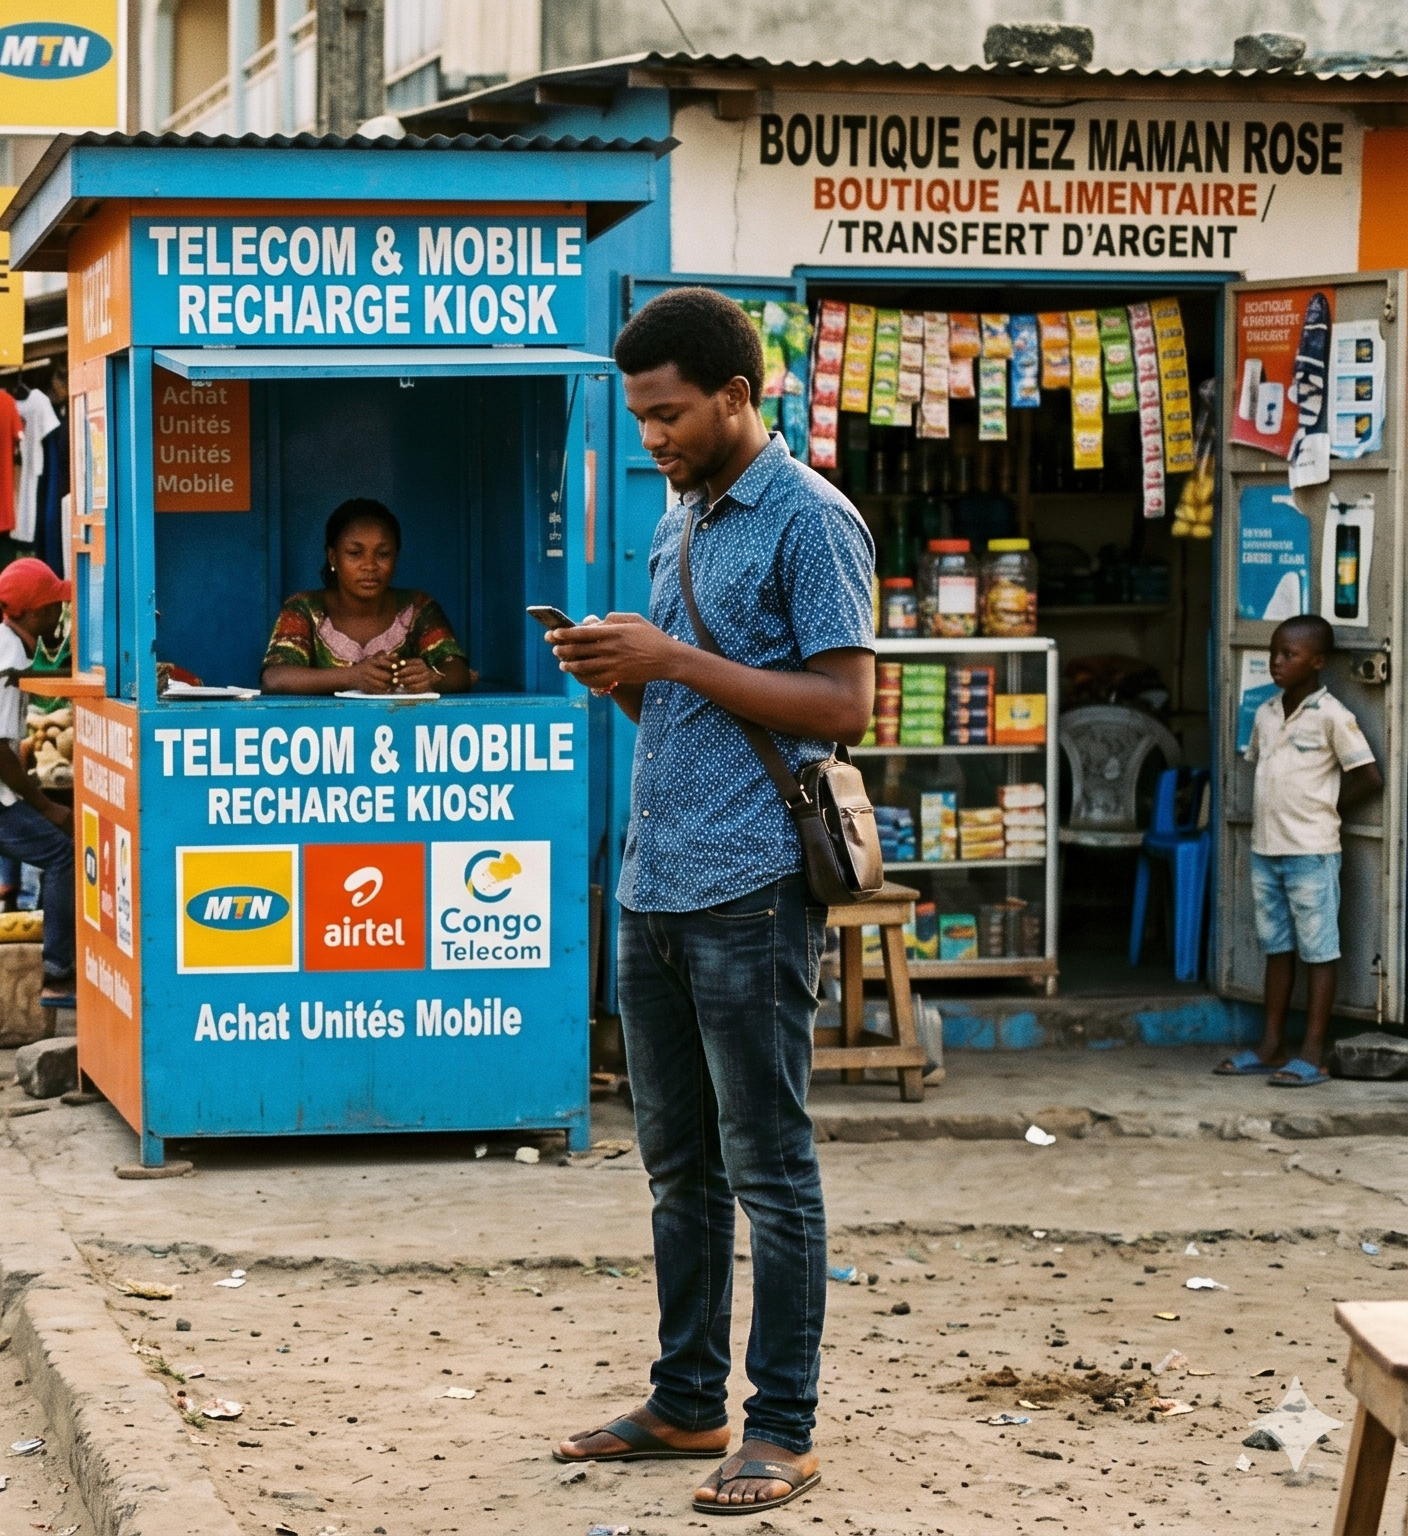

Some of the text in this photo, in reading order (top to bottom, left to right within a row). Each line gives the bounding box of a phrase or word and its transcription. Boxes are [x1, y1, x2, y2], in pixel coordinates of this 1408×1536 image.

[0, 36, 88, 66] MTN
[760, 113, 1343, 175] BOUTIQUE CHEZ MAMAN ROSE
[814, 178, 998, 213] BOUTIQUE
[150, 227, 581, 275] TELECOM & MOBILE
[1063, 224, 1237, 258] D'ARGENT
[180, 285, 557, 334] RECHARGE KIOSK
[162, 386, 228, 405] Achat
[159, 414, 231, 434] Unités
[160, 443, 232, 464] Unités
[157, 473, 234, 493] Mobile
[155, 727, 354, 776] TELECOM
[371, 726, 399, 773] &
[416, 724, 573, 772] MOBILE
[209, 785, 513, 824] RECHARGE KIOSK
[204, 896, 272, 919] MTN
[441, 907, 542, 940] Congo
[324, 917, 404, 946] airtel
[441, 941, 541, 961] Telecom
[195, 999, 521, 1040] Achat Unités Mobile
